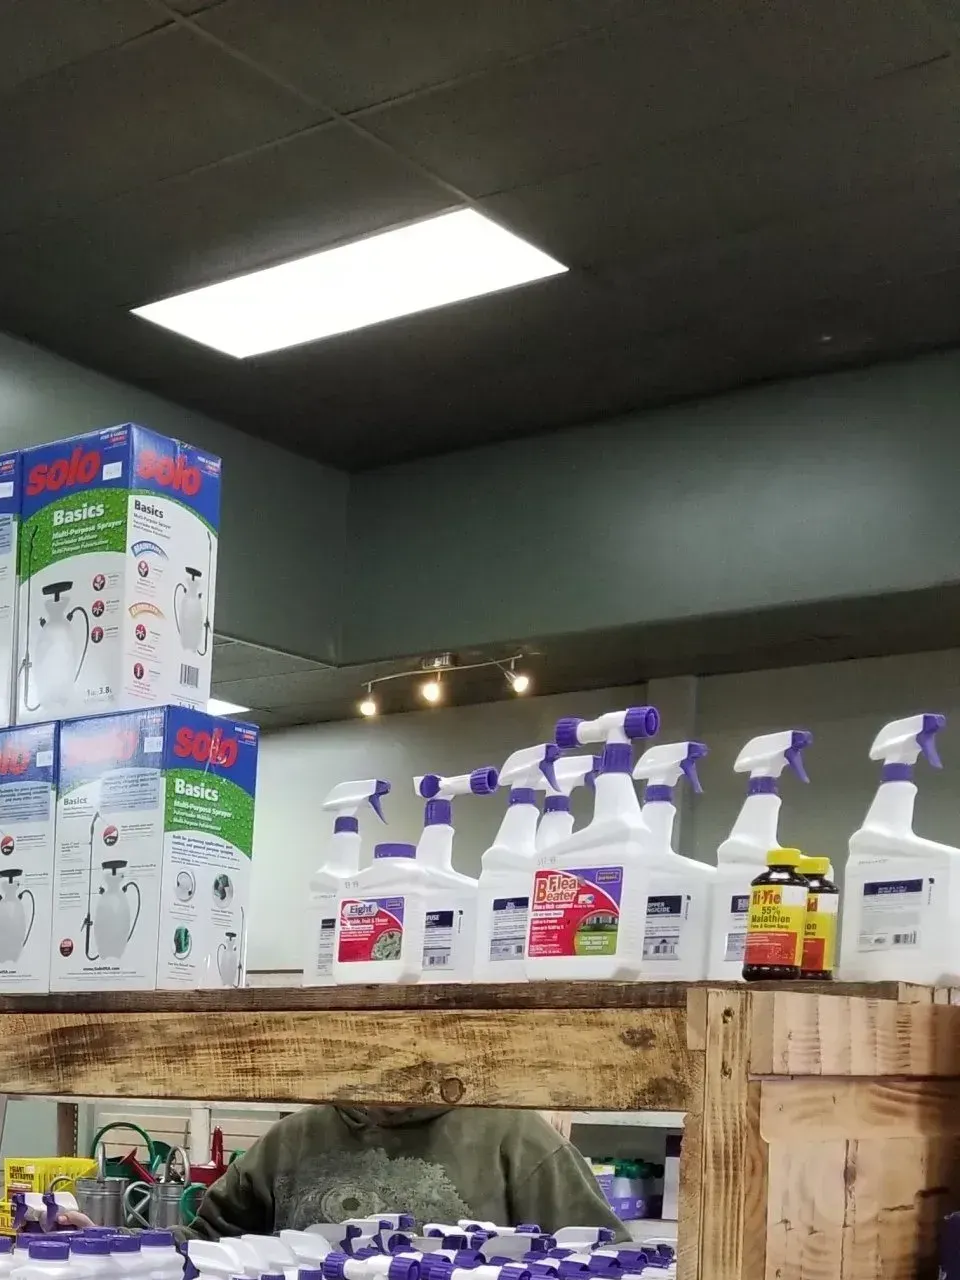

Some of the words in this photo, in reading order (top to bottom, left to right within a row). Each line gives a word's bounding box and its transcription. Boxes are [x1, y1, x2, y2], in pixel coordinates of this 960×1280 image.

[26, 446, 100, 496] solo
[137, 450, 201, 496] solo
[53, 503, 104, 526] Basics
[134, 500, 164, 519] Basics
[174, 726, 237, 767] solo
[175, 778, 219, 801] Basics
[64, 797, 87, 805] Basics
[549, 875, 577, 890] Flea
[350, 904, 372, 915] Eight
[752, 914, 790, 924] Malathion
